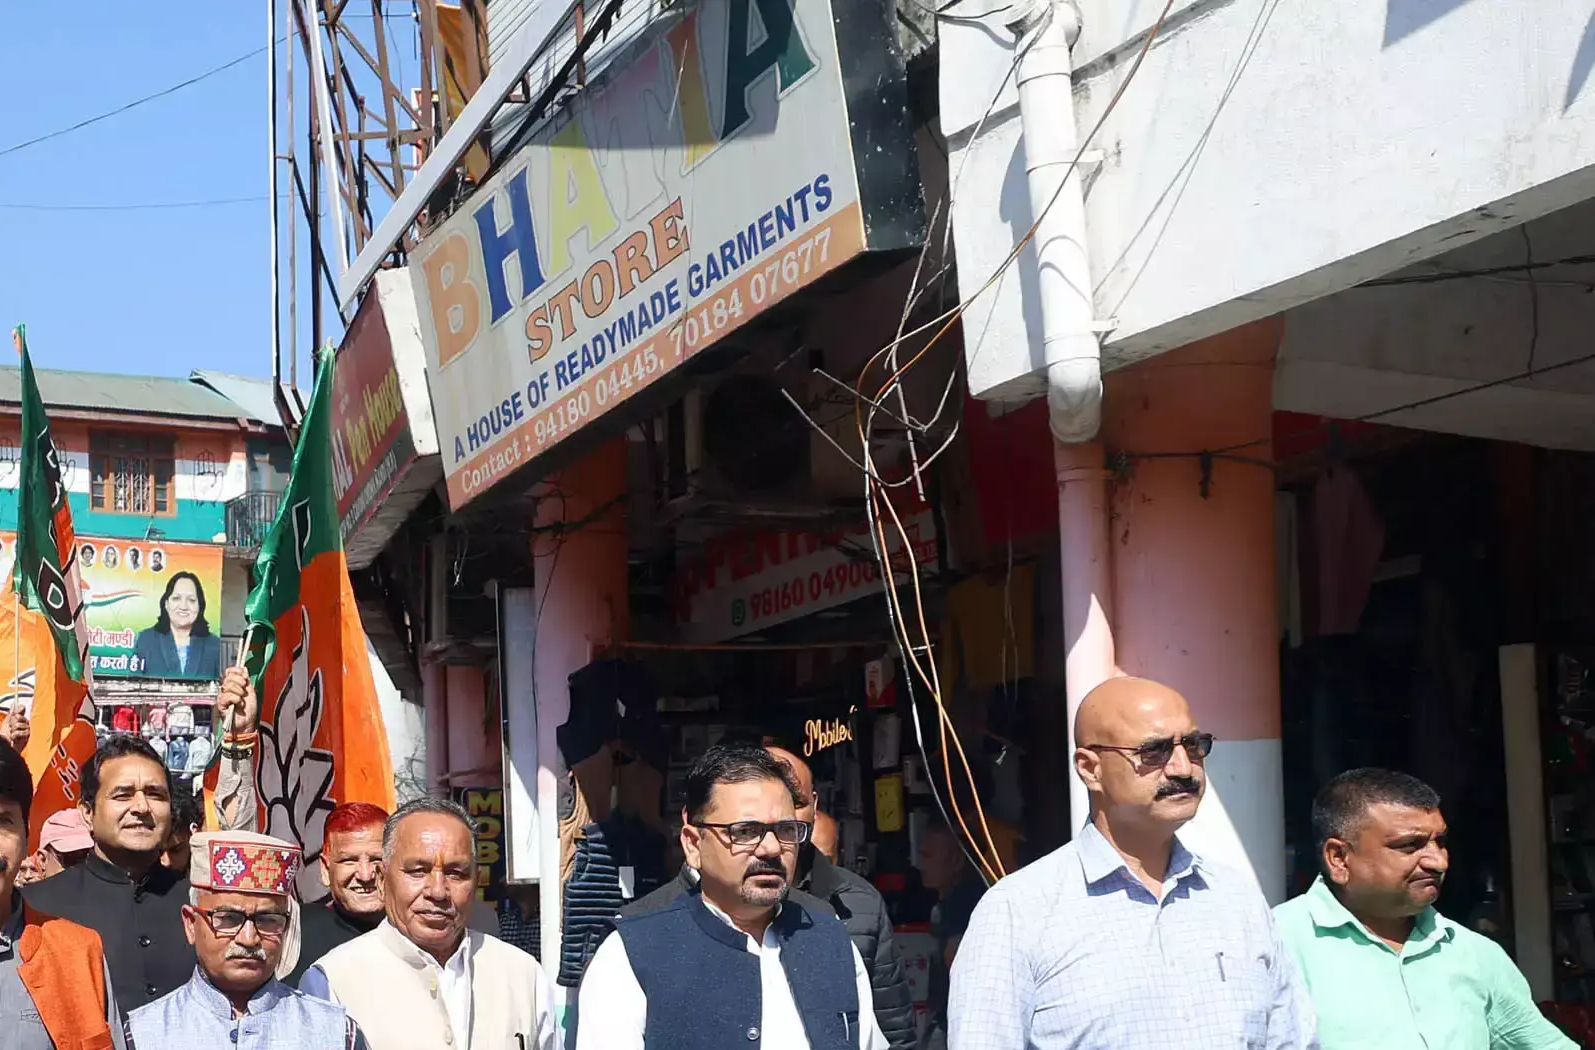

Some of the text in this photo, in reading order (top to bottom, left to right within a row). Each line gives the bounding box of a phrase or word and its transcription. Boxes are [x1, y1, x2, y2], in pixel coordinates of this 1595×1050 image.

[454, 173, 834, 463] A HOUSE OF READYMADE GARMENTS
[461, 441, 521, 495] Contact
[534, 394, 591, 446] 94180
[669, 289, 744, 364] 70184
[749, 225, 834, 303] 07677
[524, 196, 691, 364] STORE
